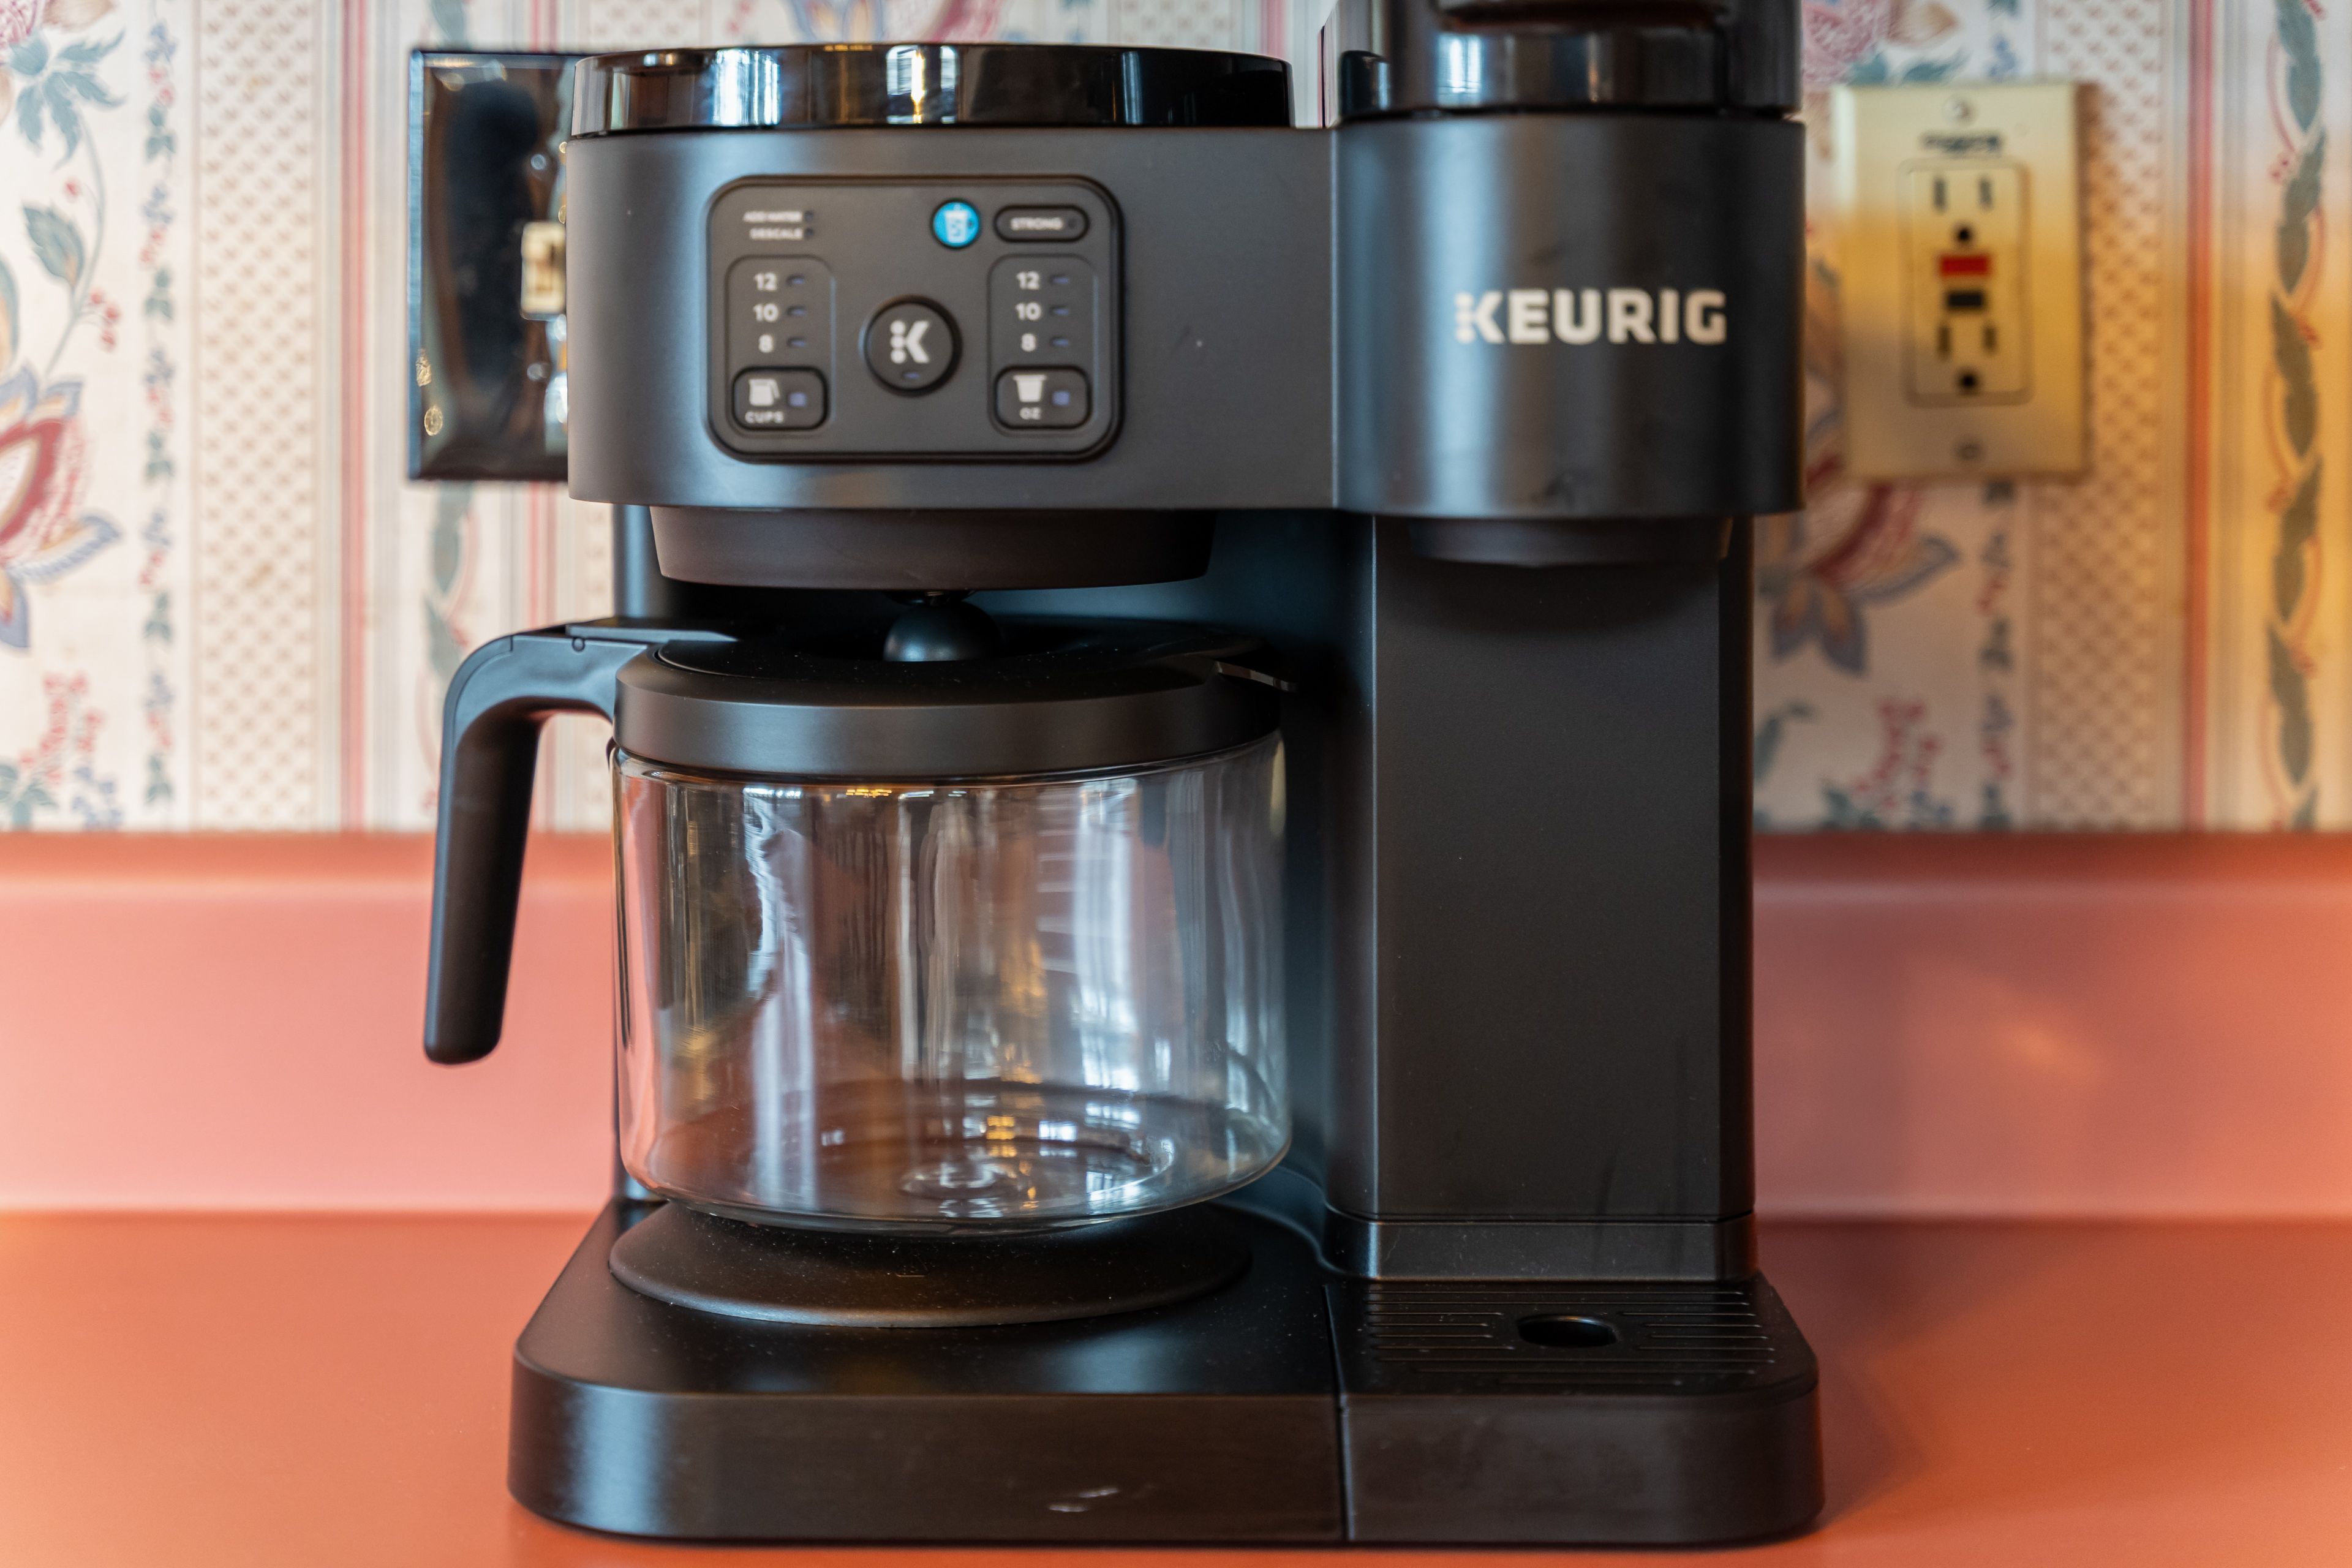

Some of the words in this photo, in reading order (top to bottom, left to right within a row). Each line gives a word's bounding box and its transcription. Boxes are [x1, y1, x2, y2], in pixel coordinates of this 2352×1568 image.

[1010, 217, 1063, 230] STRONG
[750, 228, 803, 239] DESCALE
[755, 272, 777, 291] 12
[1016, 271, 1039, 290] 12
[753, 303, 779, 322] 10
[1016, 302, 1041, 320] 10
[1456, 288, 1727, 344] KEURIG
[759, 334, 774, 353] 8
[1021, 333, 1036, 352] 8
[745, 411, 785, 423] CUPS
[1020, 407, 1041, 420] OZ
